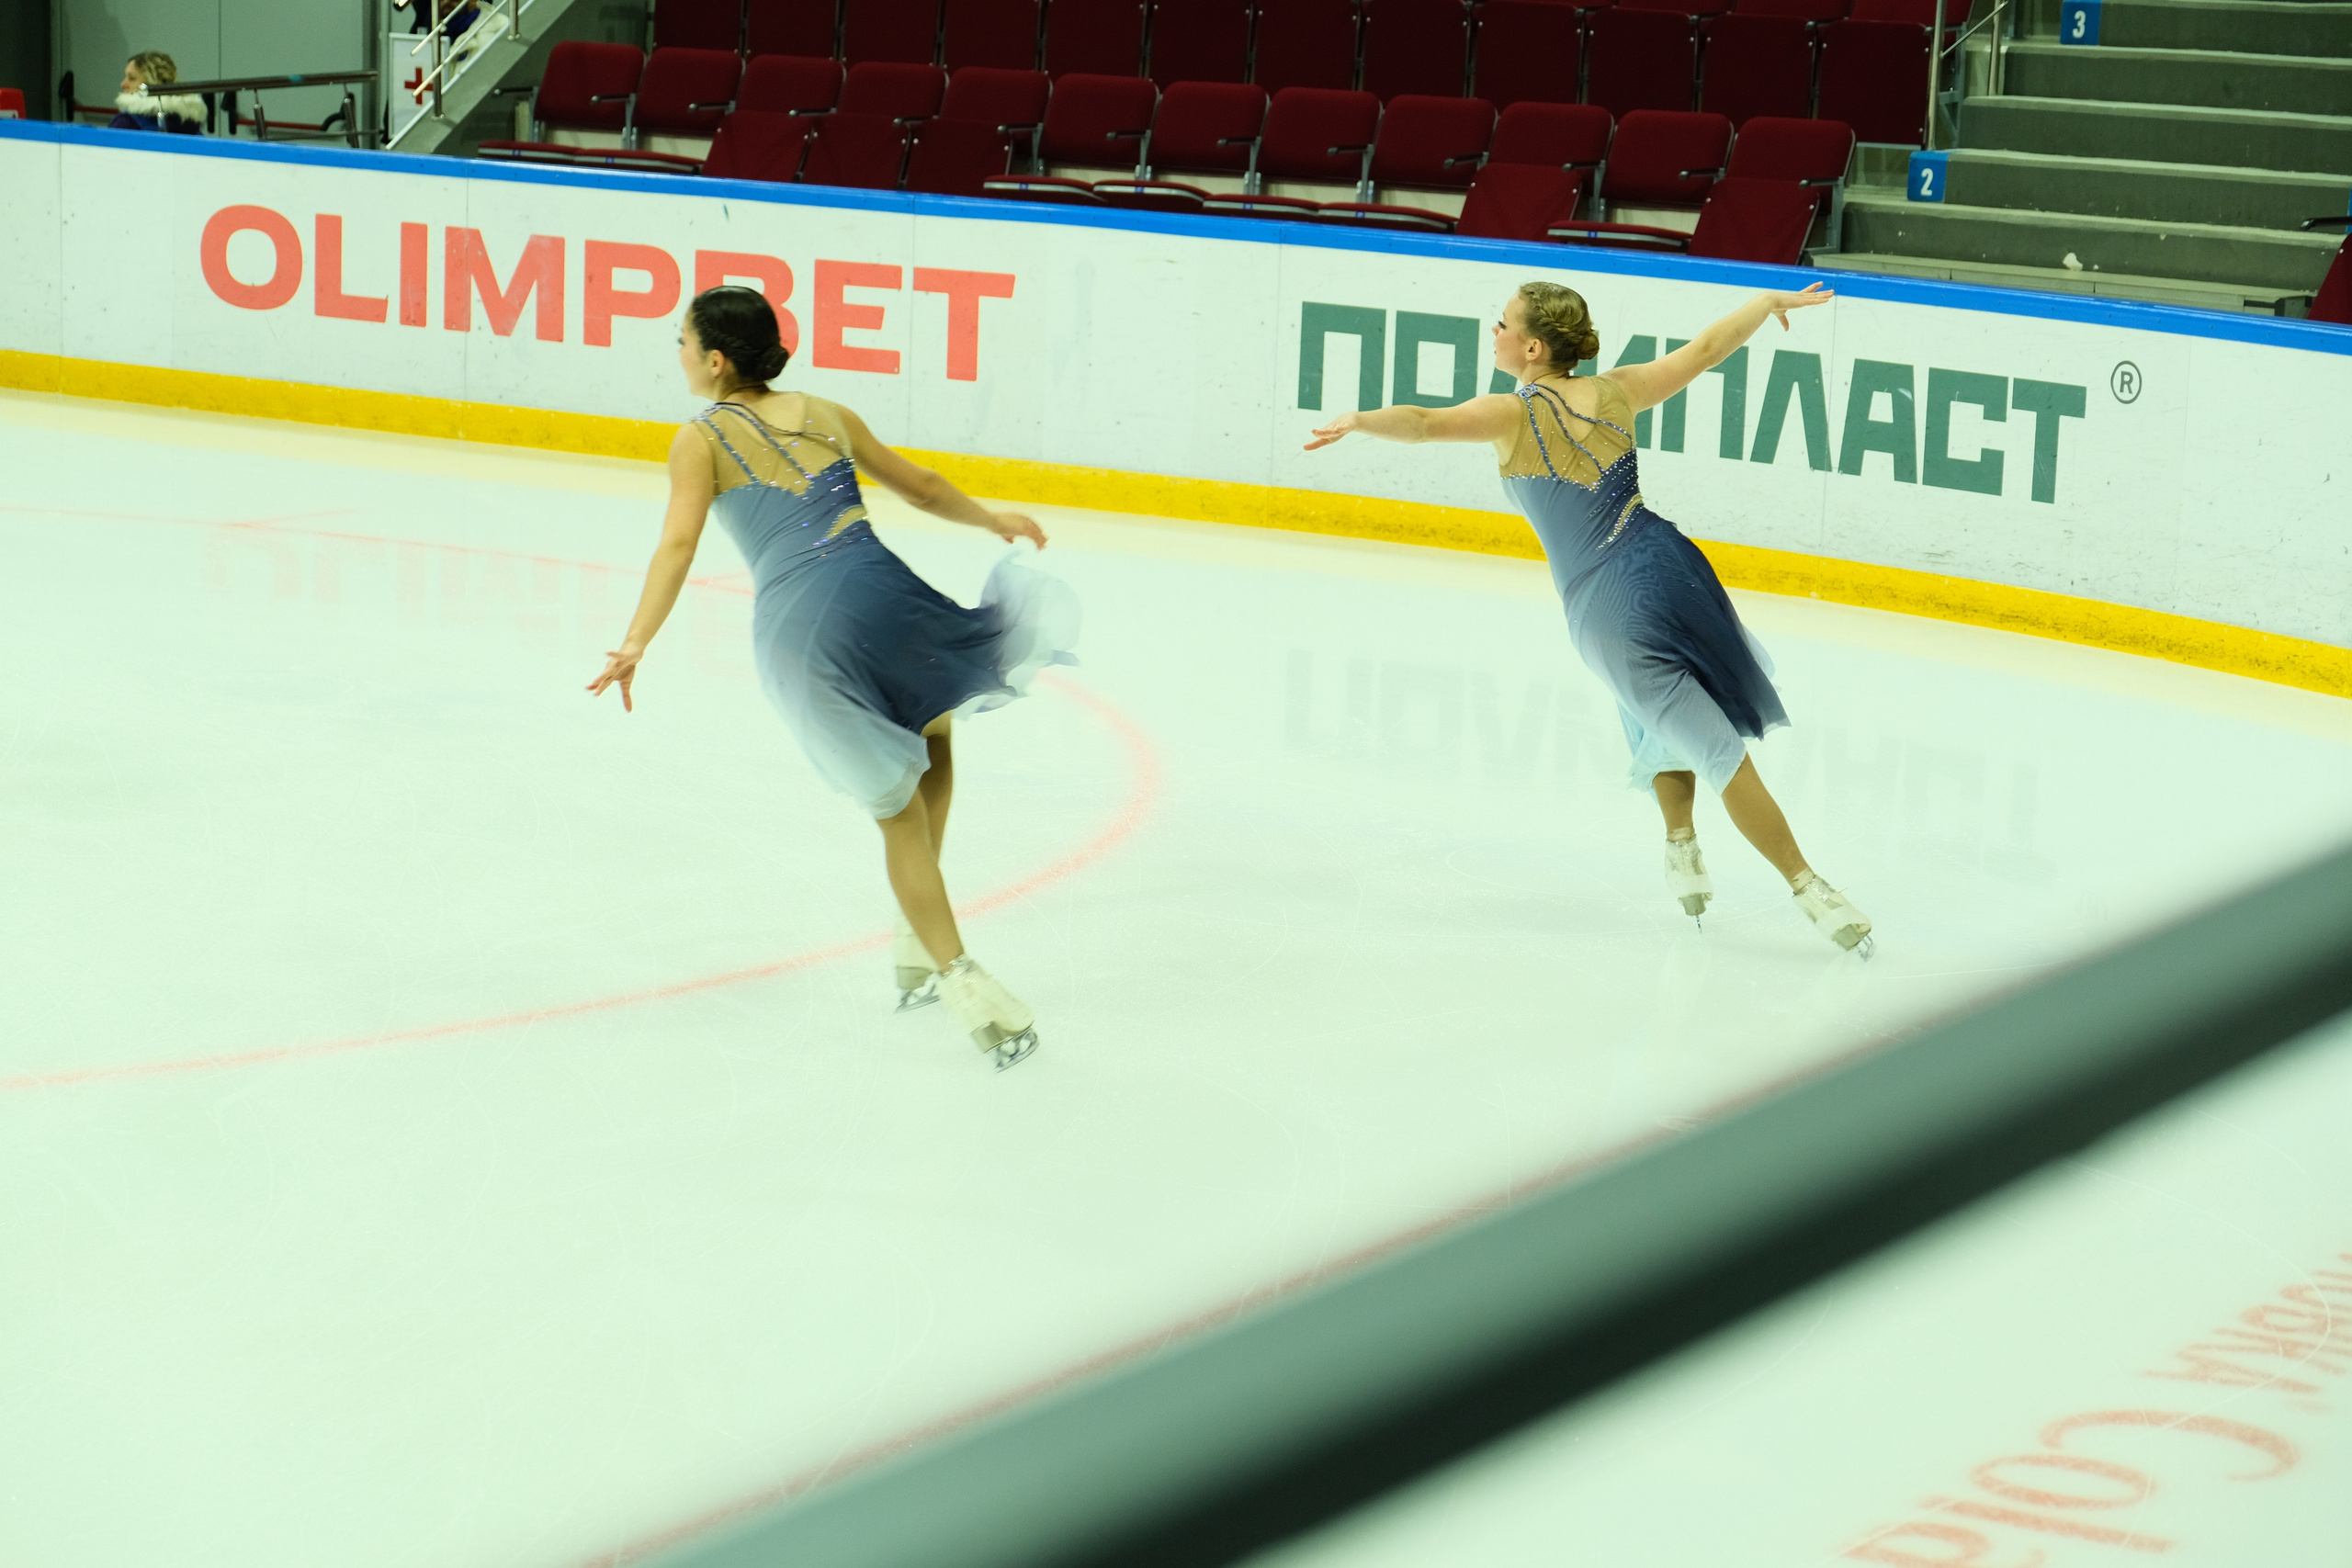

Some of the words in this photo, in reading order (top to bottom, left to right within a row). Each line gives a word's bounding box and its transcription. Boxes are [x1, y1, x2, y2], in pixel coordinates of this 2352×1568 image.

[2072, 10, 2086, 39] 3
[1920, 168, 1933, 197] 2
[1297, 301, 2086, 503] ПОПЛАСТ
